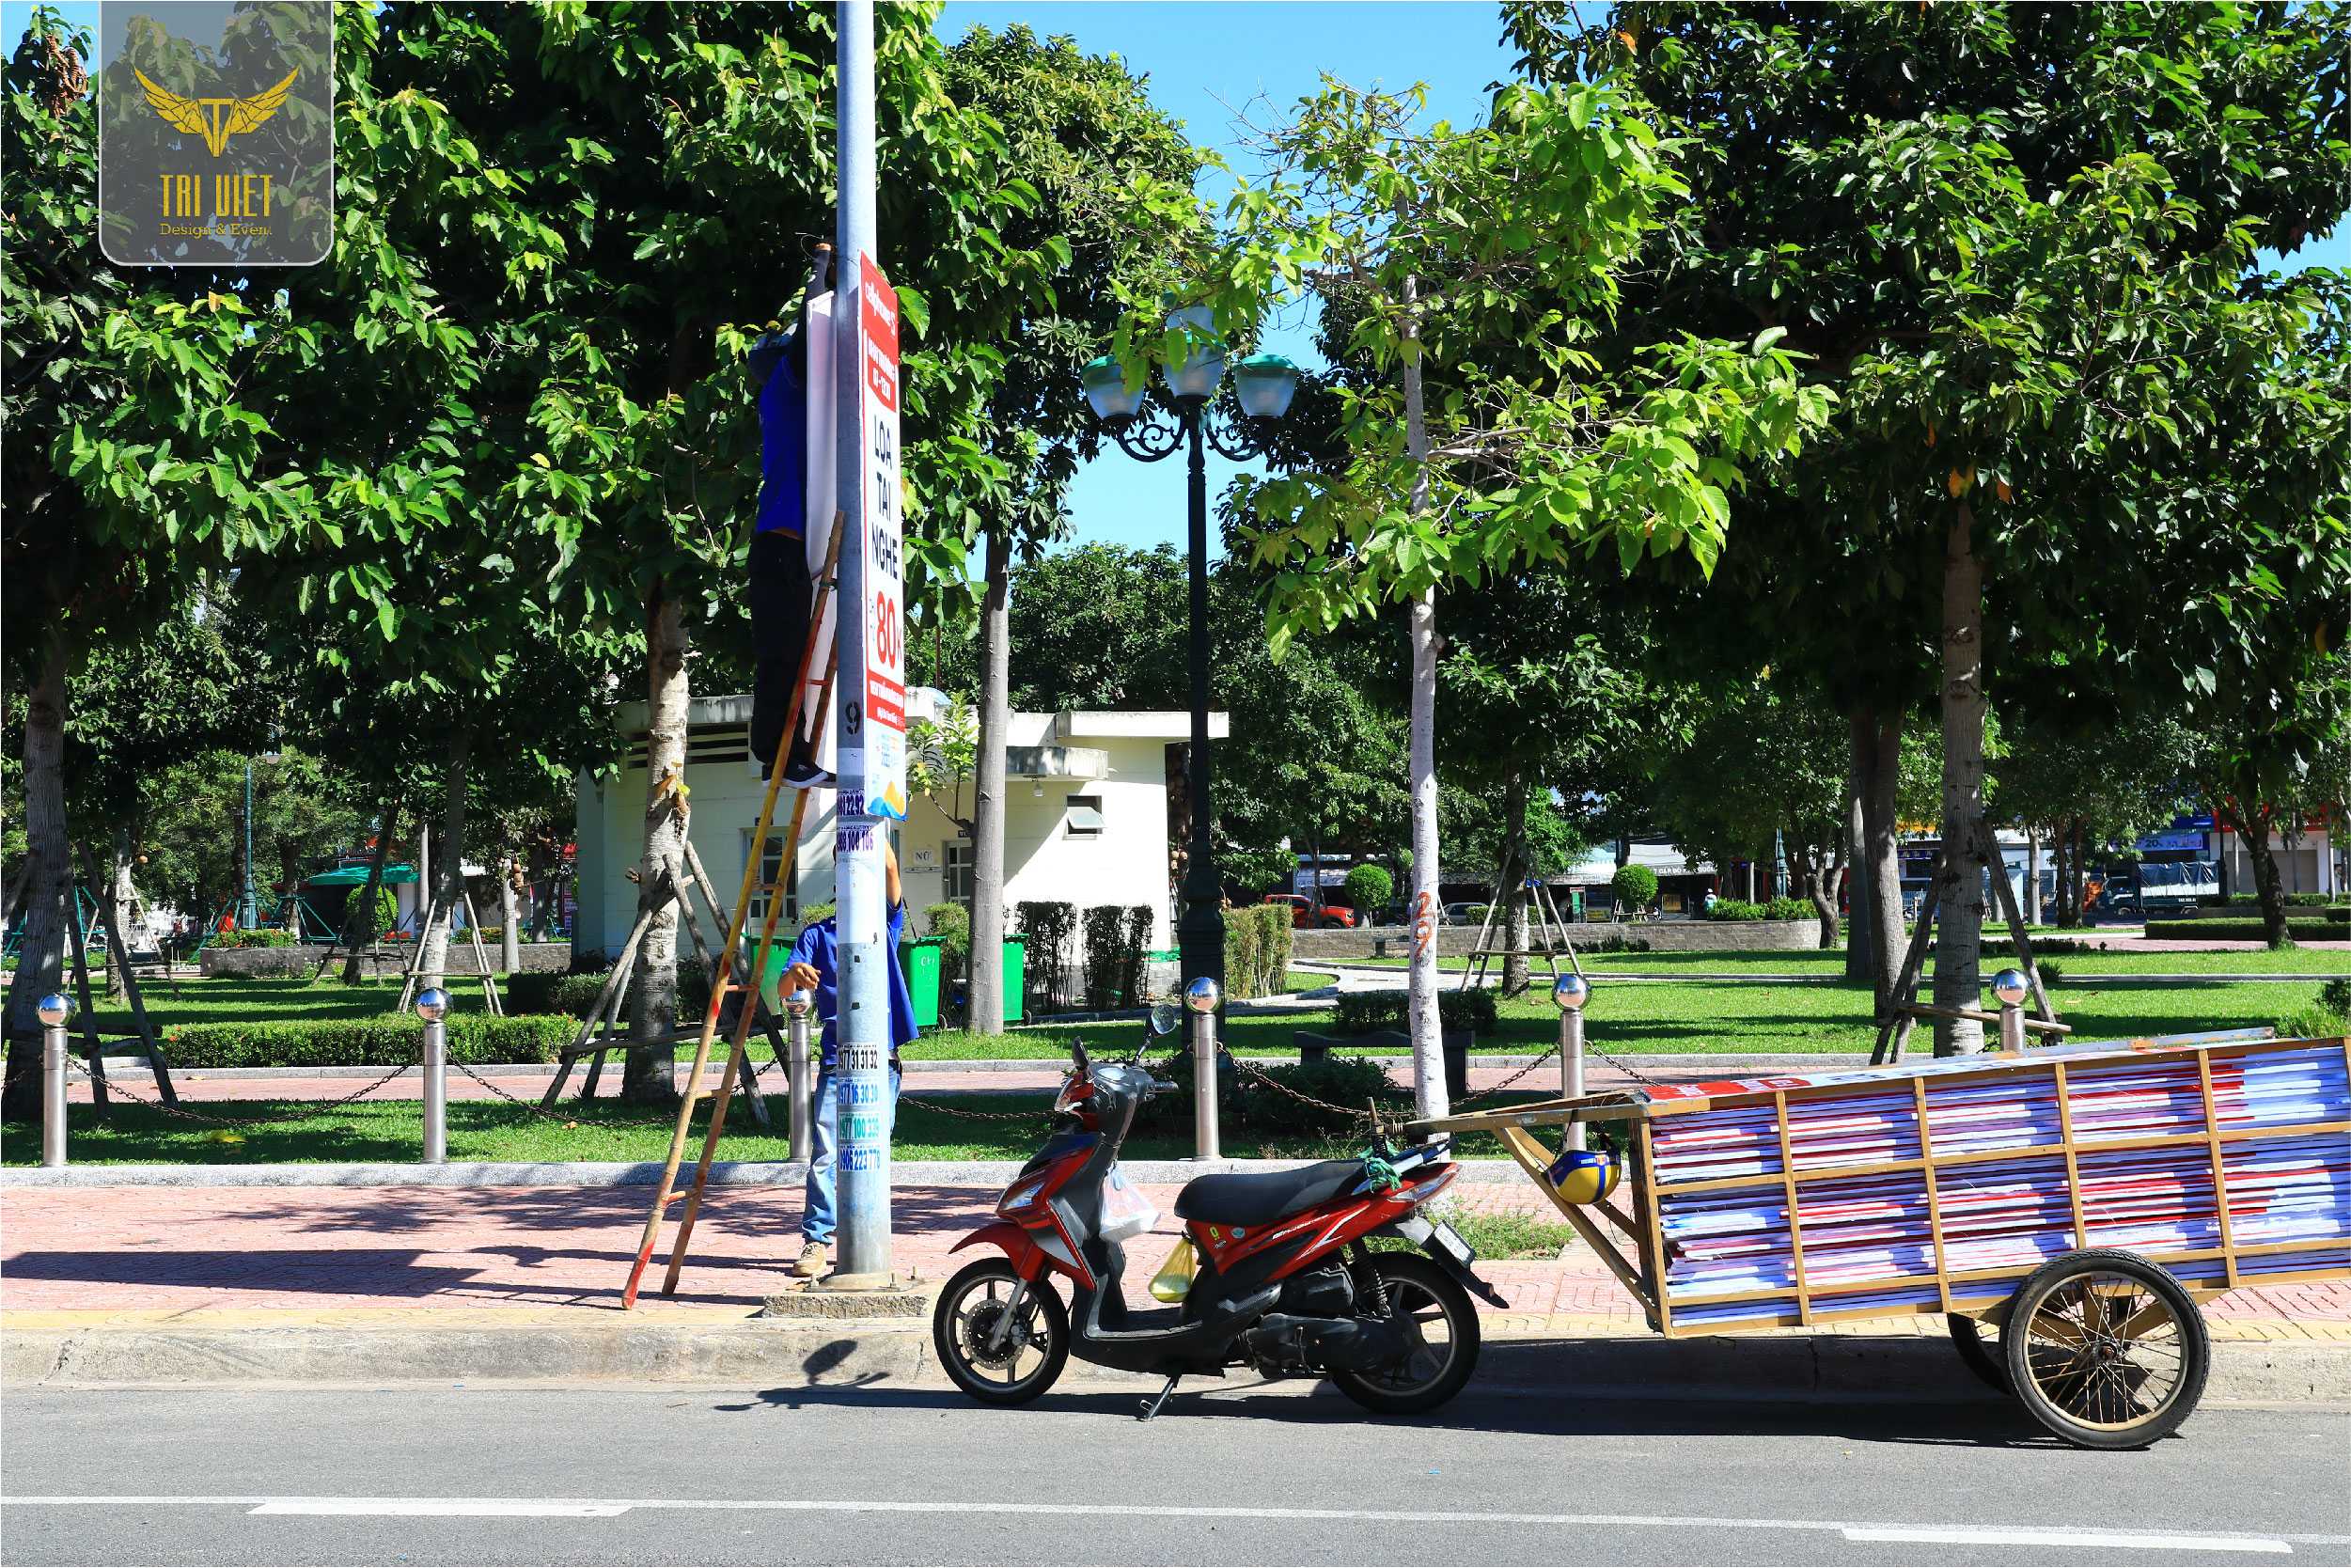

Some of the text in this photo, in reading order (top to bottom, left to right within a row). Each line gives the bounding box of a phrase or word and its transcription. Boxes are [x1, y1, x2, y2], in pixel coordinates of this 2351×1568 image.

[874, 415, 892, 470] LOA
[876, 471, 891, 522] TAI
[871, 522, 898, 581] NGHE
[845, 701, 860, 735] 9
